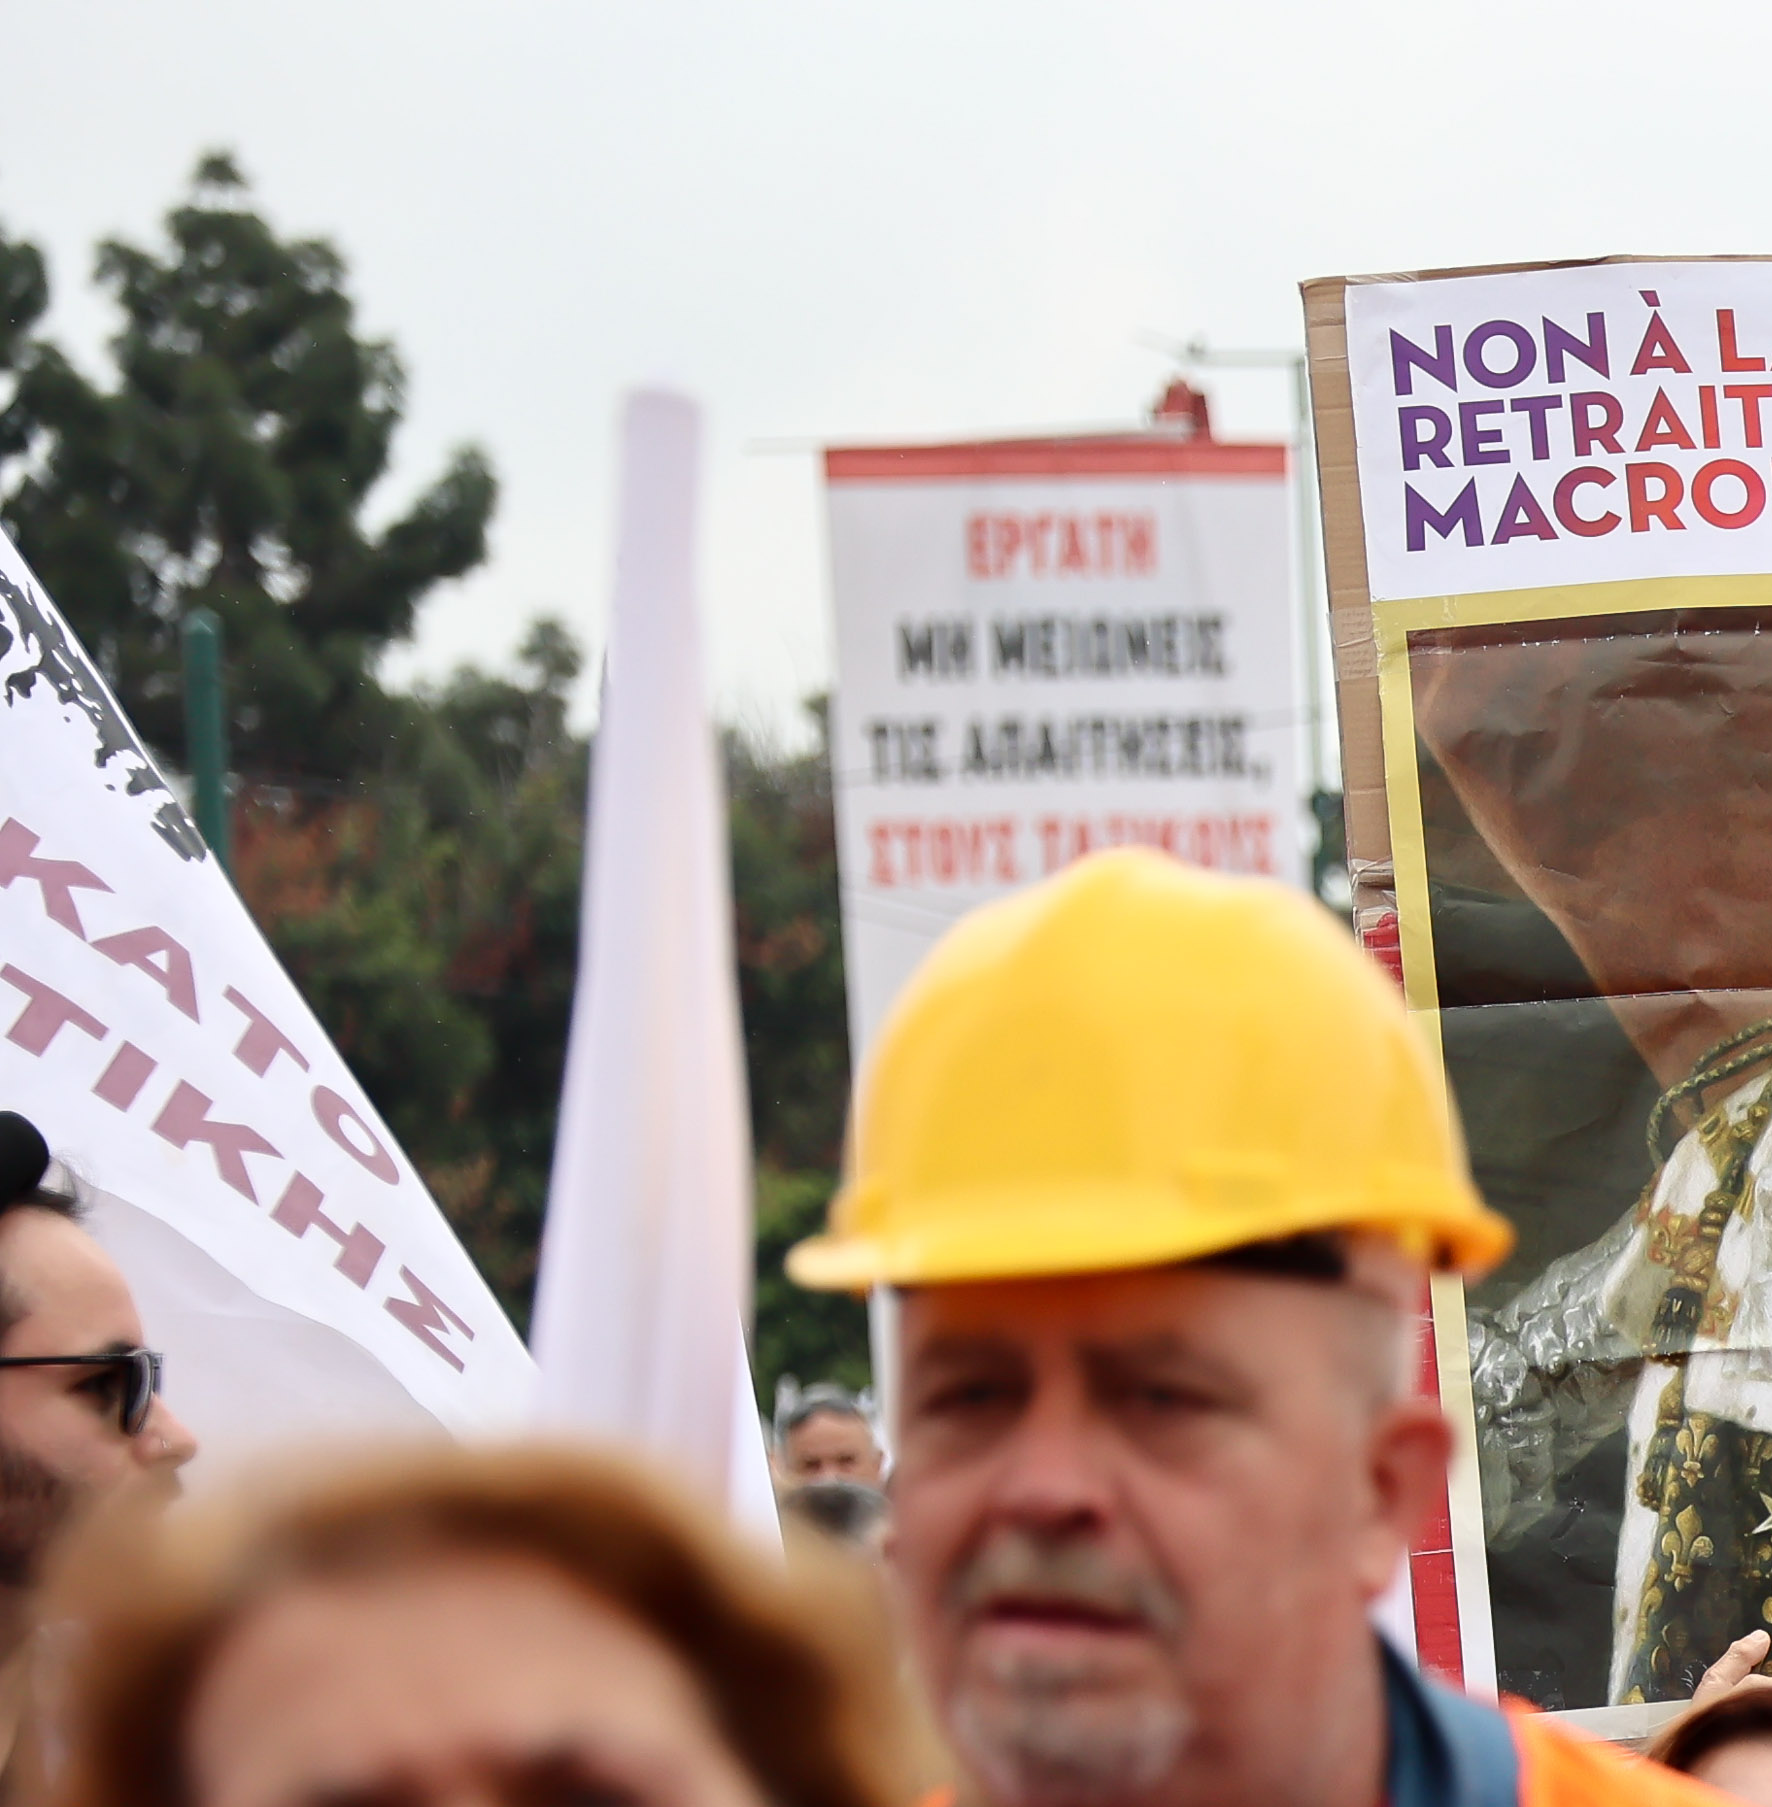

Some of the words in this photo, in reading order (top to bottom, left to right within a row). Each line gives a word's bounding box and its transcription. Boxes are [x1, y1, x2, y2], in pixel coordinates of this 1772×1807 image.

[1390, 312, 1611, 397] NON
[1630, 290, 1693, 376] À
[966, 511, 1158, 578] ΕΡΓΑΤΗ
[896, 617, 971, 681] ΜΗ
[867, 716, 938, 782] ΤΙΣ
[871, 817, 1018, 888] ΣΤΟΥΣ
